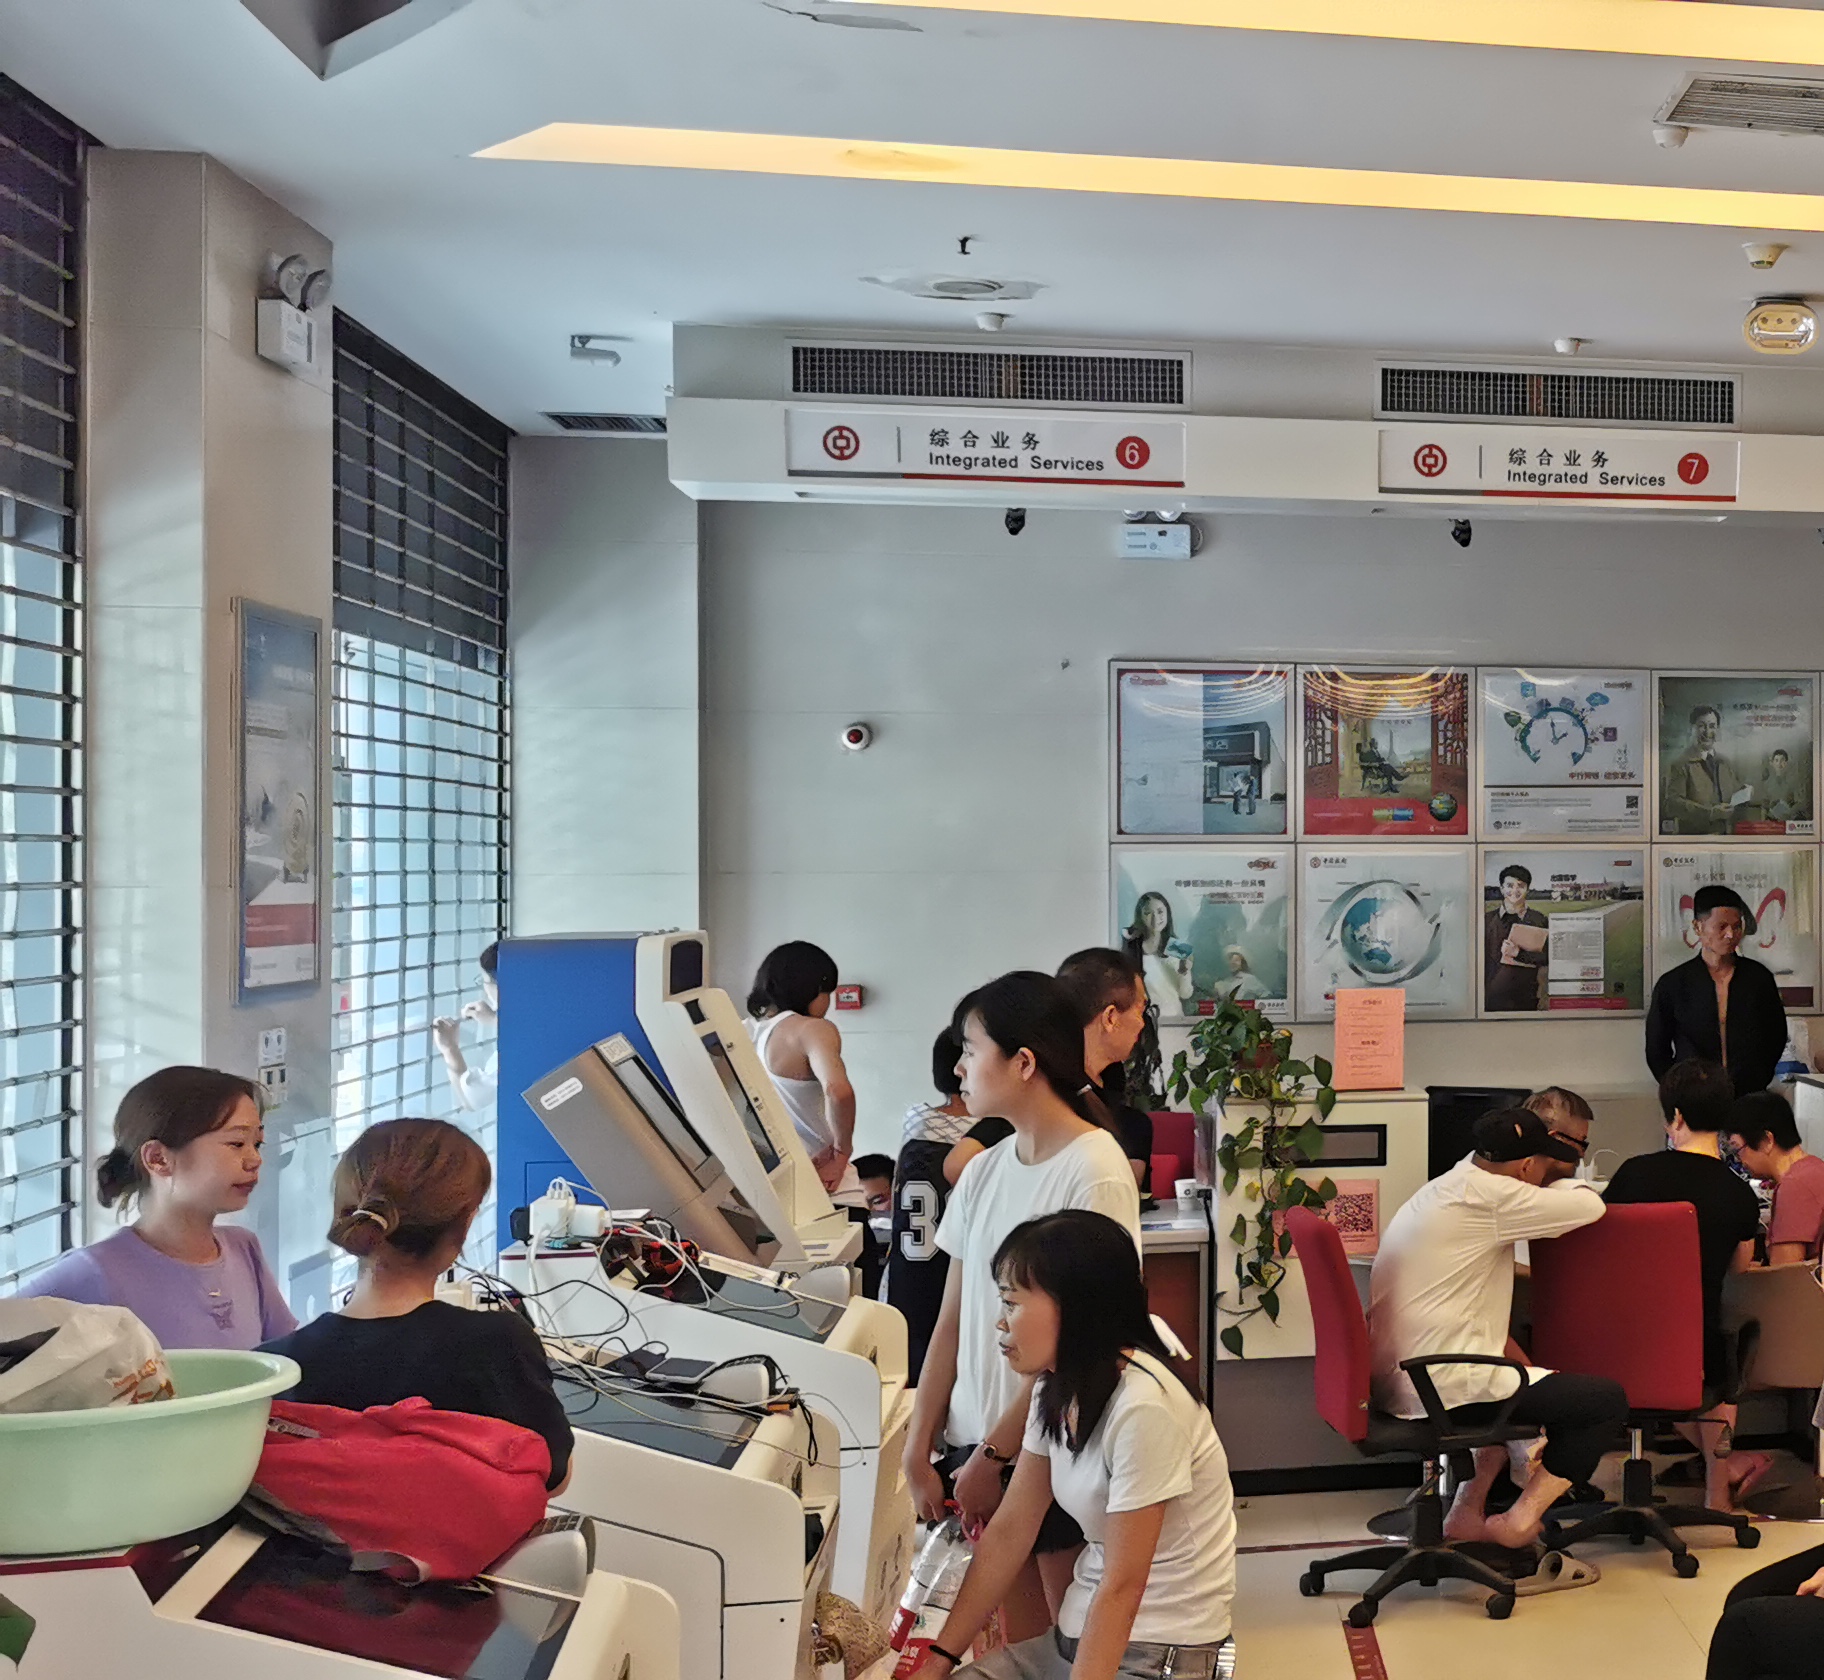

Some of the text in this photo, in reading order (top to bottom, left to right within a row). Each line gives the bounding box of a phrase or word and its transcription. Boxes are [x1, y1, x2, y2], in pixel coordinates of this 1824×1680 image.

[928, 427, 1041, 451] 综合业务
[928, 452, 1104, 472] Integrated Services
[1507, 446, 1610, 468] 综合业务
[1506, 469, 1666, 487] Integrated Services
[900, 1179, 952, 1262] 3
